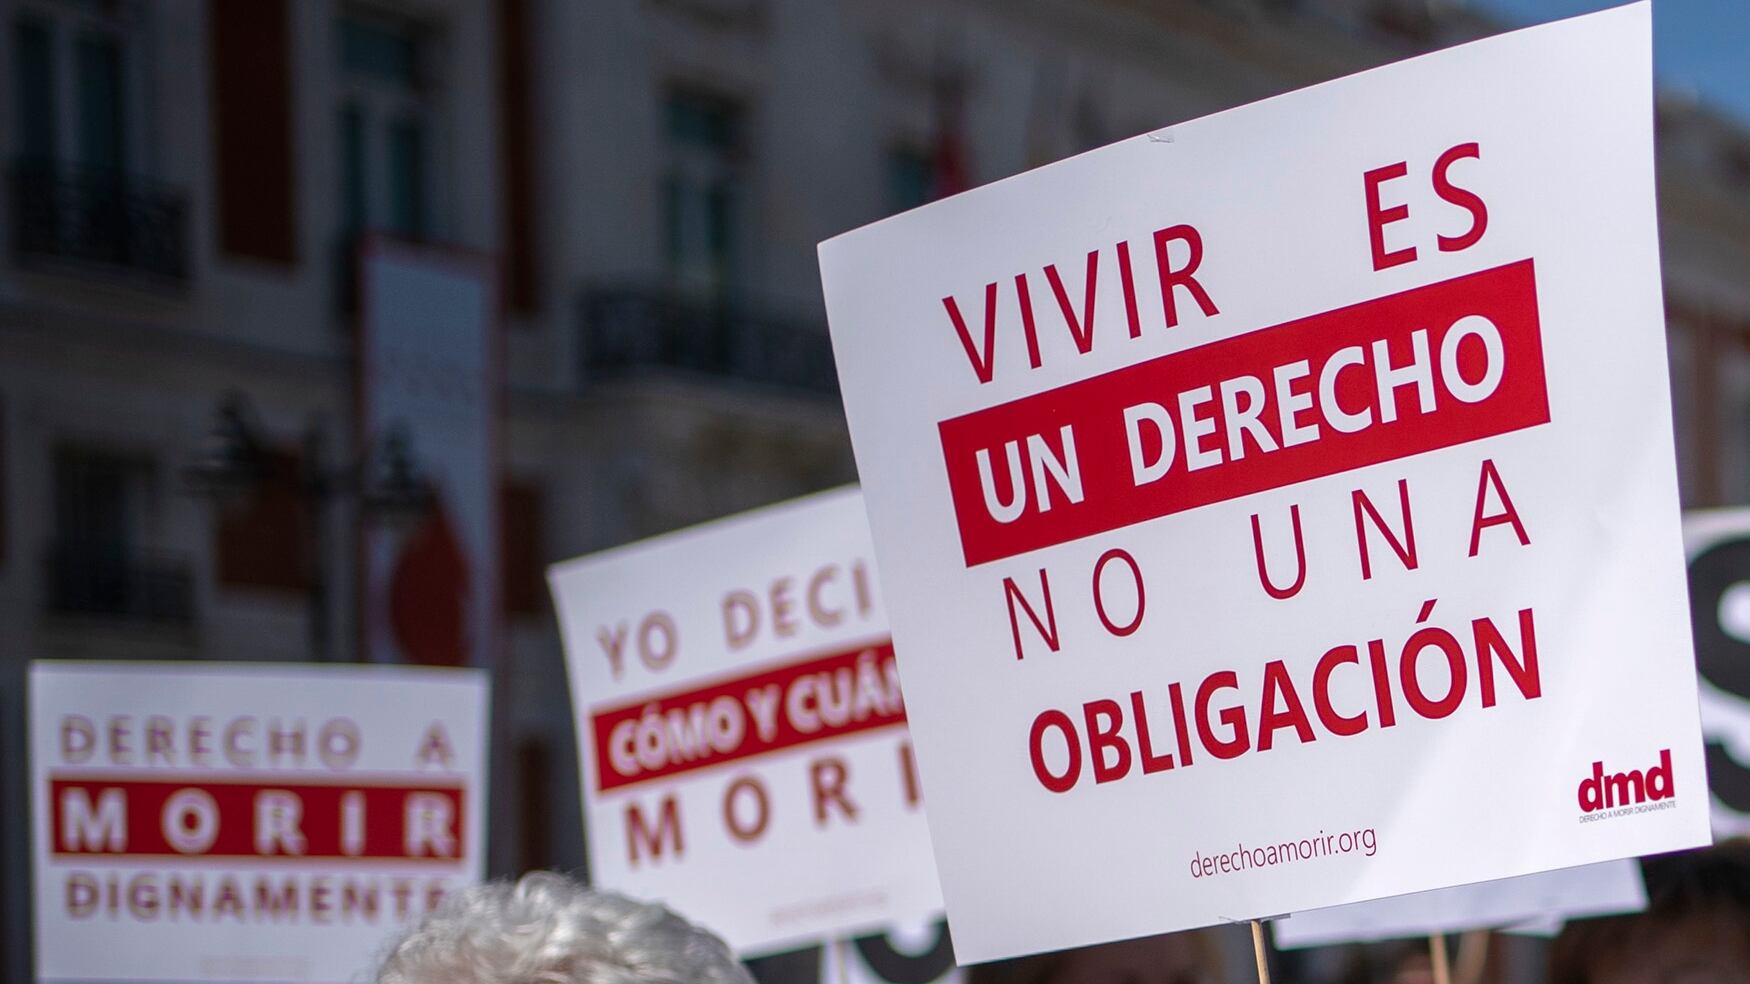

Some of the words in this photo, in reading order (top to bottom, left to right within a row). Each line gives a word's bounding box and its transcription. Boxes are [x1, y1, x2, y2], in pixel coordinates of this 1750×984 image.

[943, 224, 1220, 384] VIVIR
[1363, 142, 1489, 273] ES
[975, 424, 1085, 523] UN
[1123, 314, 1506, 487] DERECHO
[597, 610, 679, 681] YO
[721, 559, 873, 652] DECI
[1003, 548, 1146, 660] NO
[1250, 459, 1531, 601] UNA
[60, 713, 362, 769] DERECHO
[415, 719, 454, 768] A
[609, 696, 746, 776] CÓMO
[745, 683, 781, 742] Y
[1029, 599, 1543, 794] OBLIGACIÓN
[60, 786, 457, 858] MORIR
[623, 741, 921, 870] MORI
[1577, 748, 1676, 814] dmd
[1189, 827, 1378, 878] derechoamorir.org
